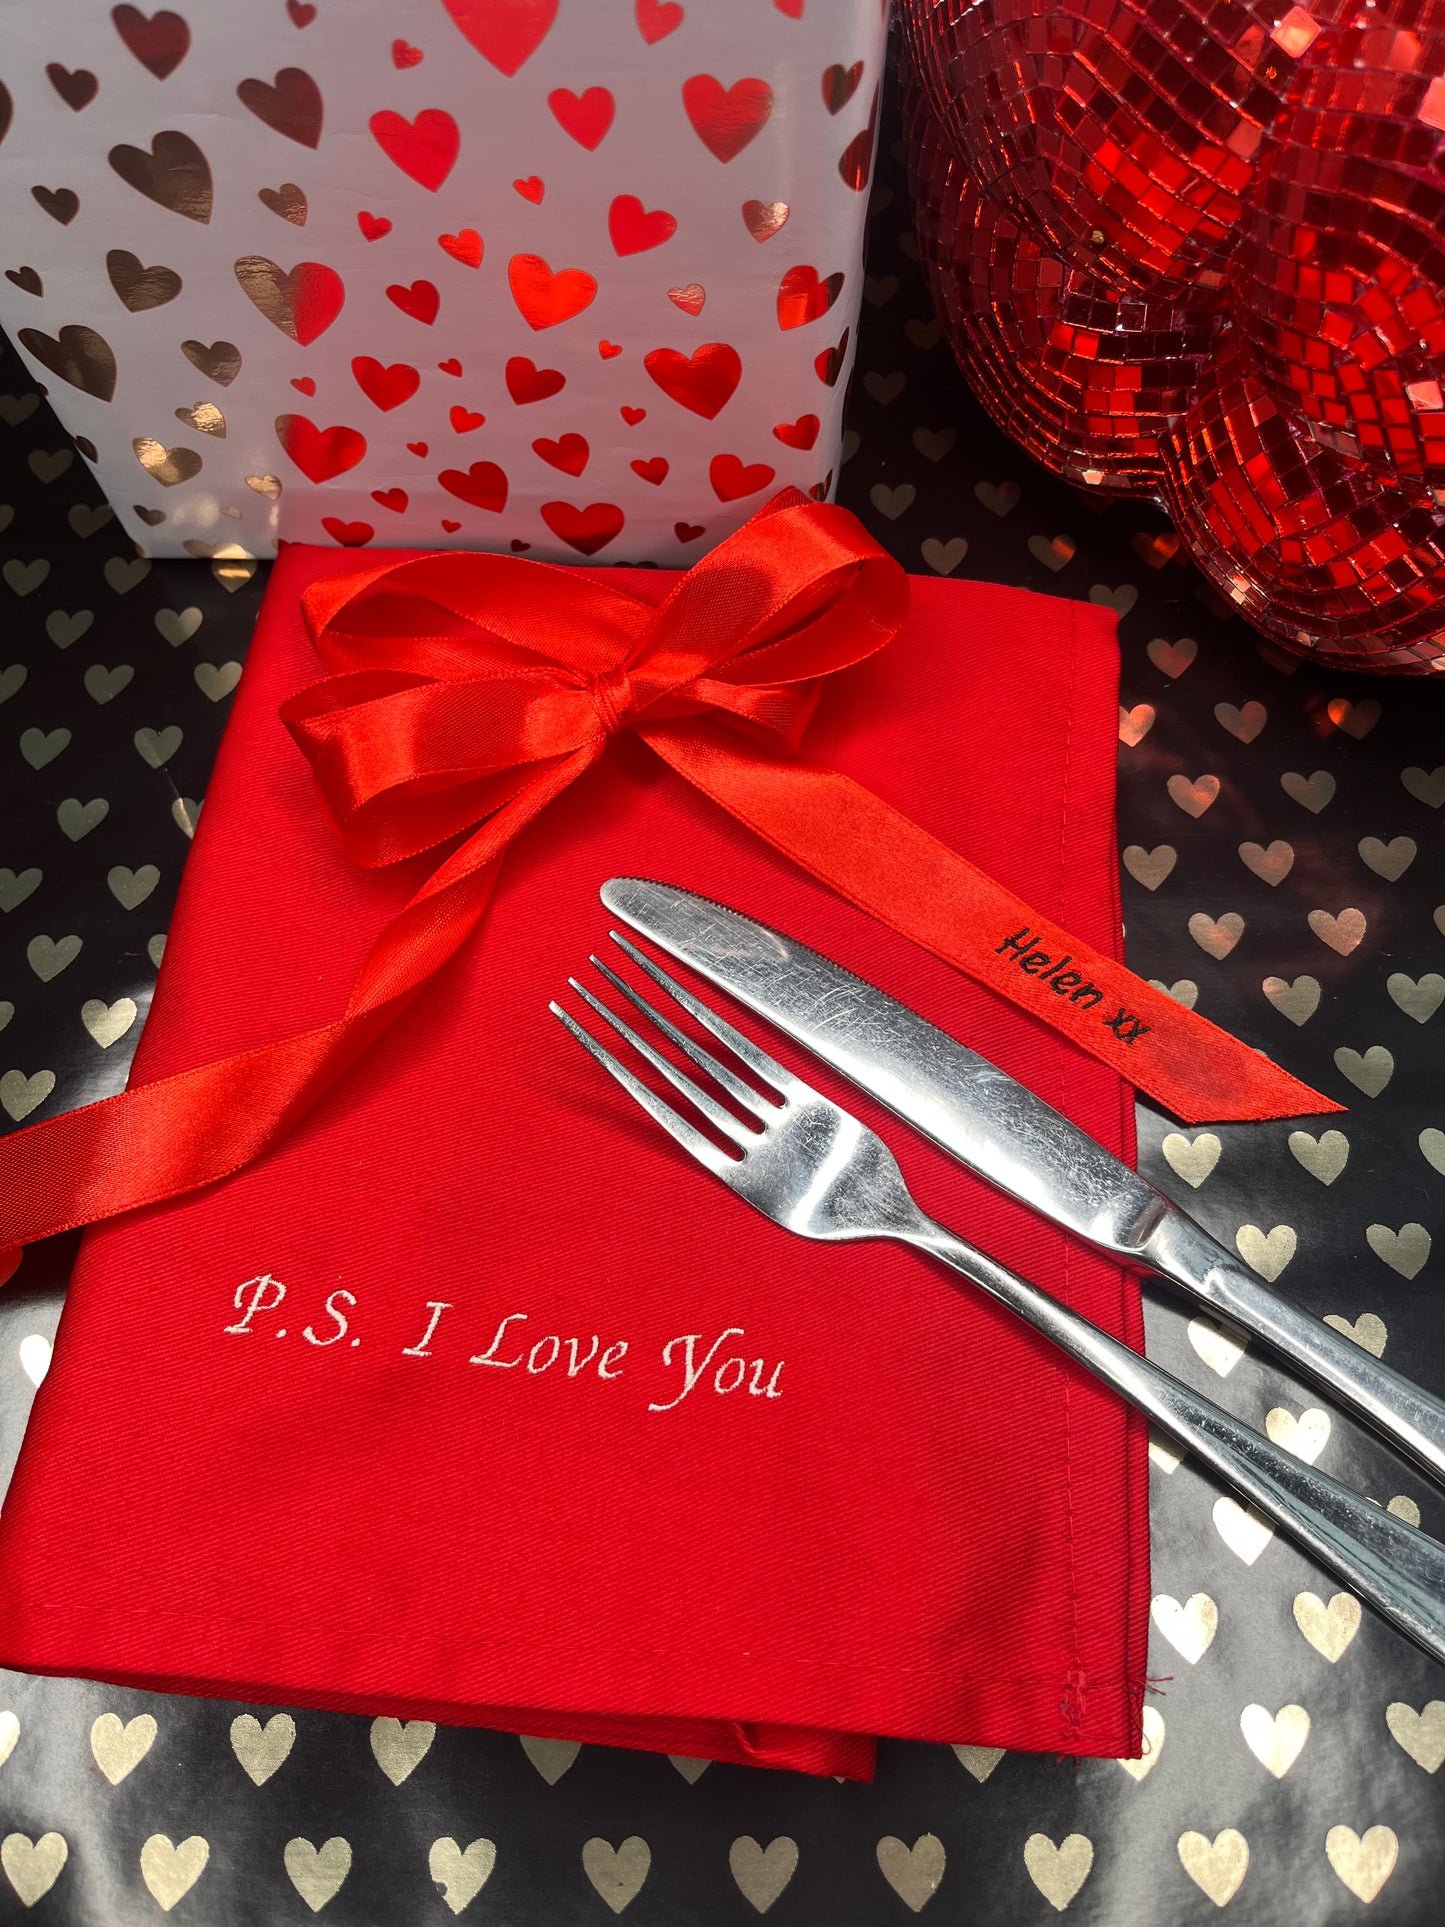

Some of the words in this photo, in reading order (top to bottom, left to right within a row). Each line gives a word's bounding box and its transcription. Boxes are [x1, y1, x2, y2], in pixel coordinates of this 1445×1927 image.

[995, 927, 1104, 1010] Helen
[1103, 1007, 1152, 1046] xx
[223, 1273, 361, 1347] P.S.
[401, 1301, 453, 1357] I
[469, 1312, 629, 1380] Love
[647, 1327, 785, 1412] You
